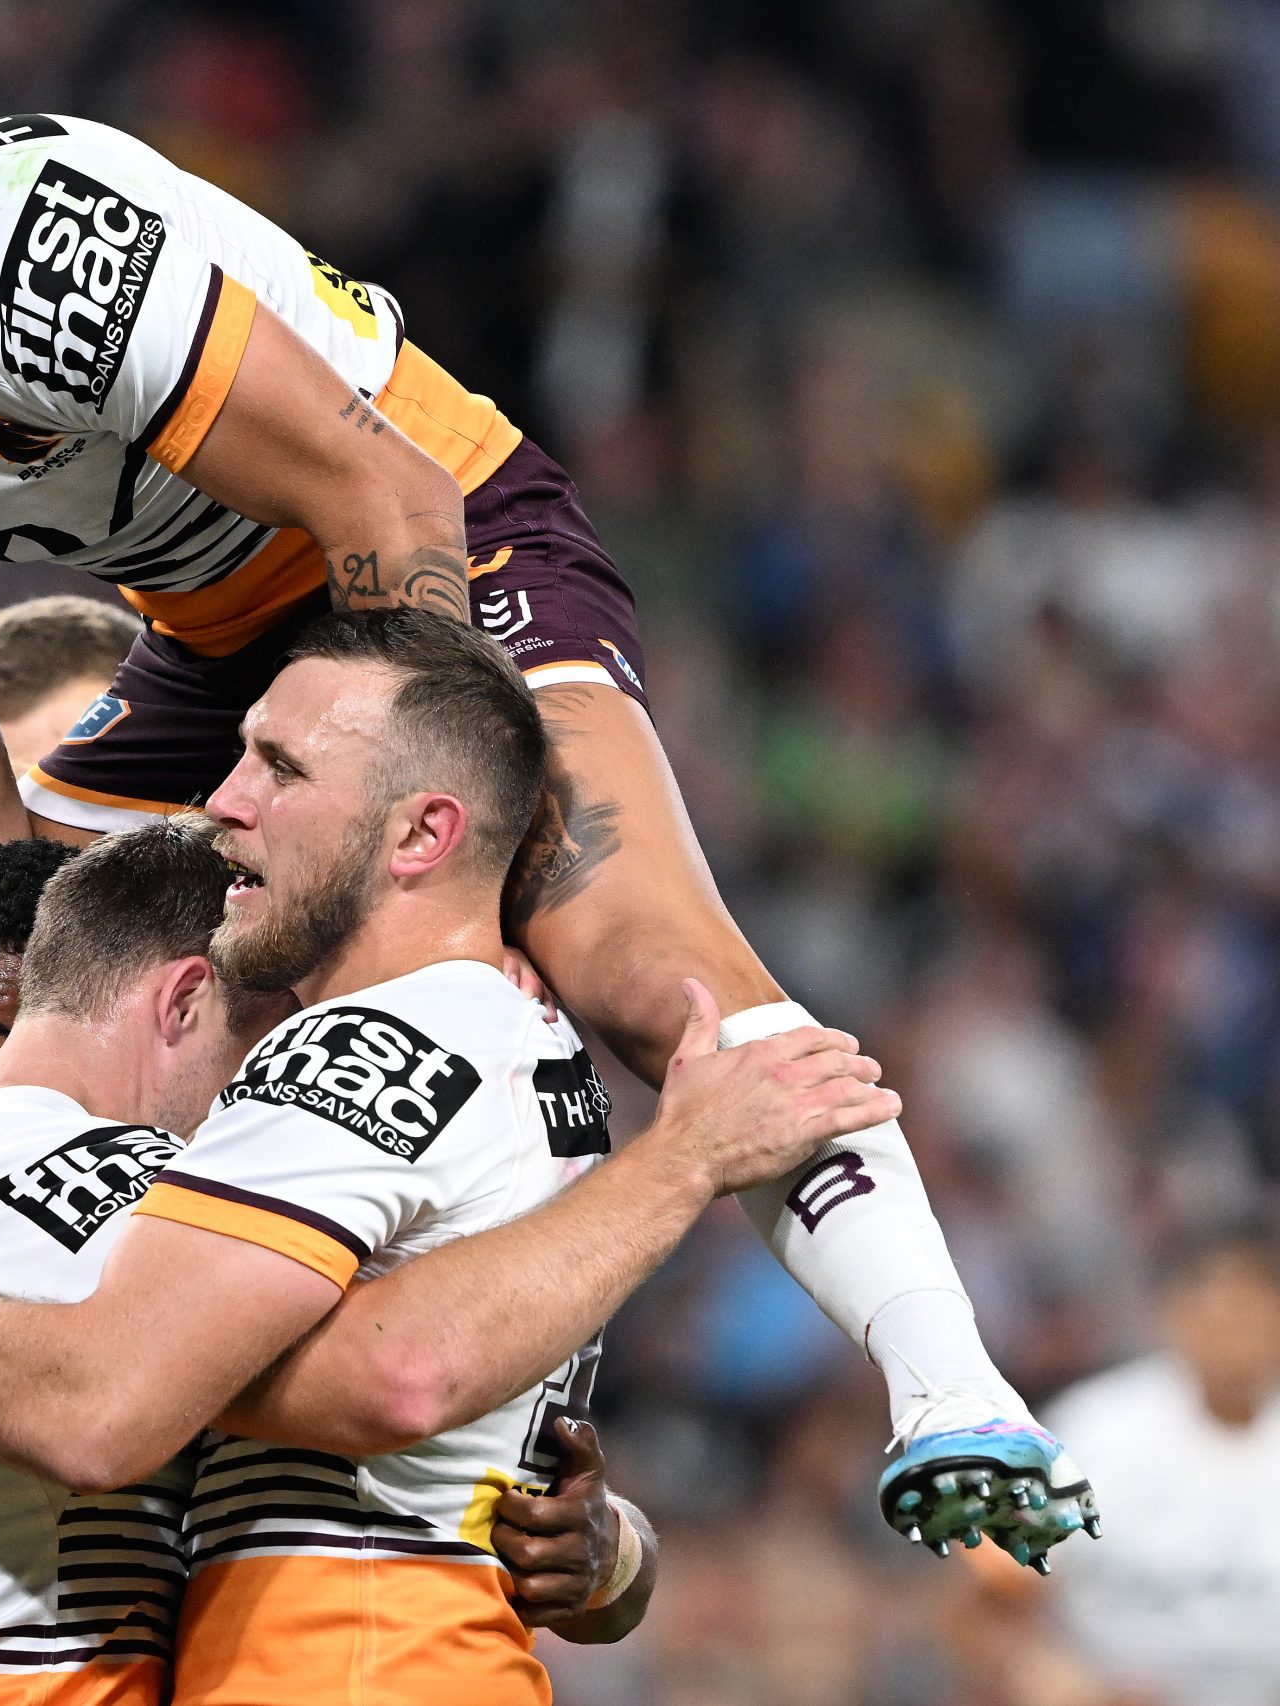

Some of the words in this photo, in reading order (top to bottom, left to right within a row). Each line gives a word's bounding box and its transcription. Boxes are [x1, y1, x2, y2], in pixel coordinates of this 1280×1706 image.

[1, 180, 95, 373] first
[54, 197, 140, 387] mac
[18, 438, 87, 481] BRNCS
[343, 550, 387, 597] 21
[503, 636, 542, 652] ELSTRA
[508, 640, 555, 658] ERSHIP
[536, 1089, 594, 1128] THE
[45, 1142, 184, 1226] ma
[785, 1150, 877, 1234] B
